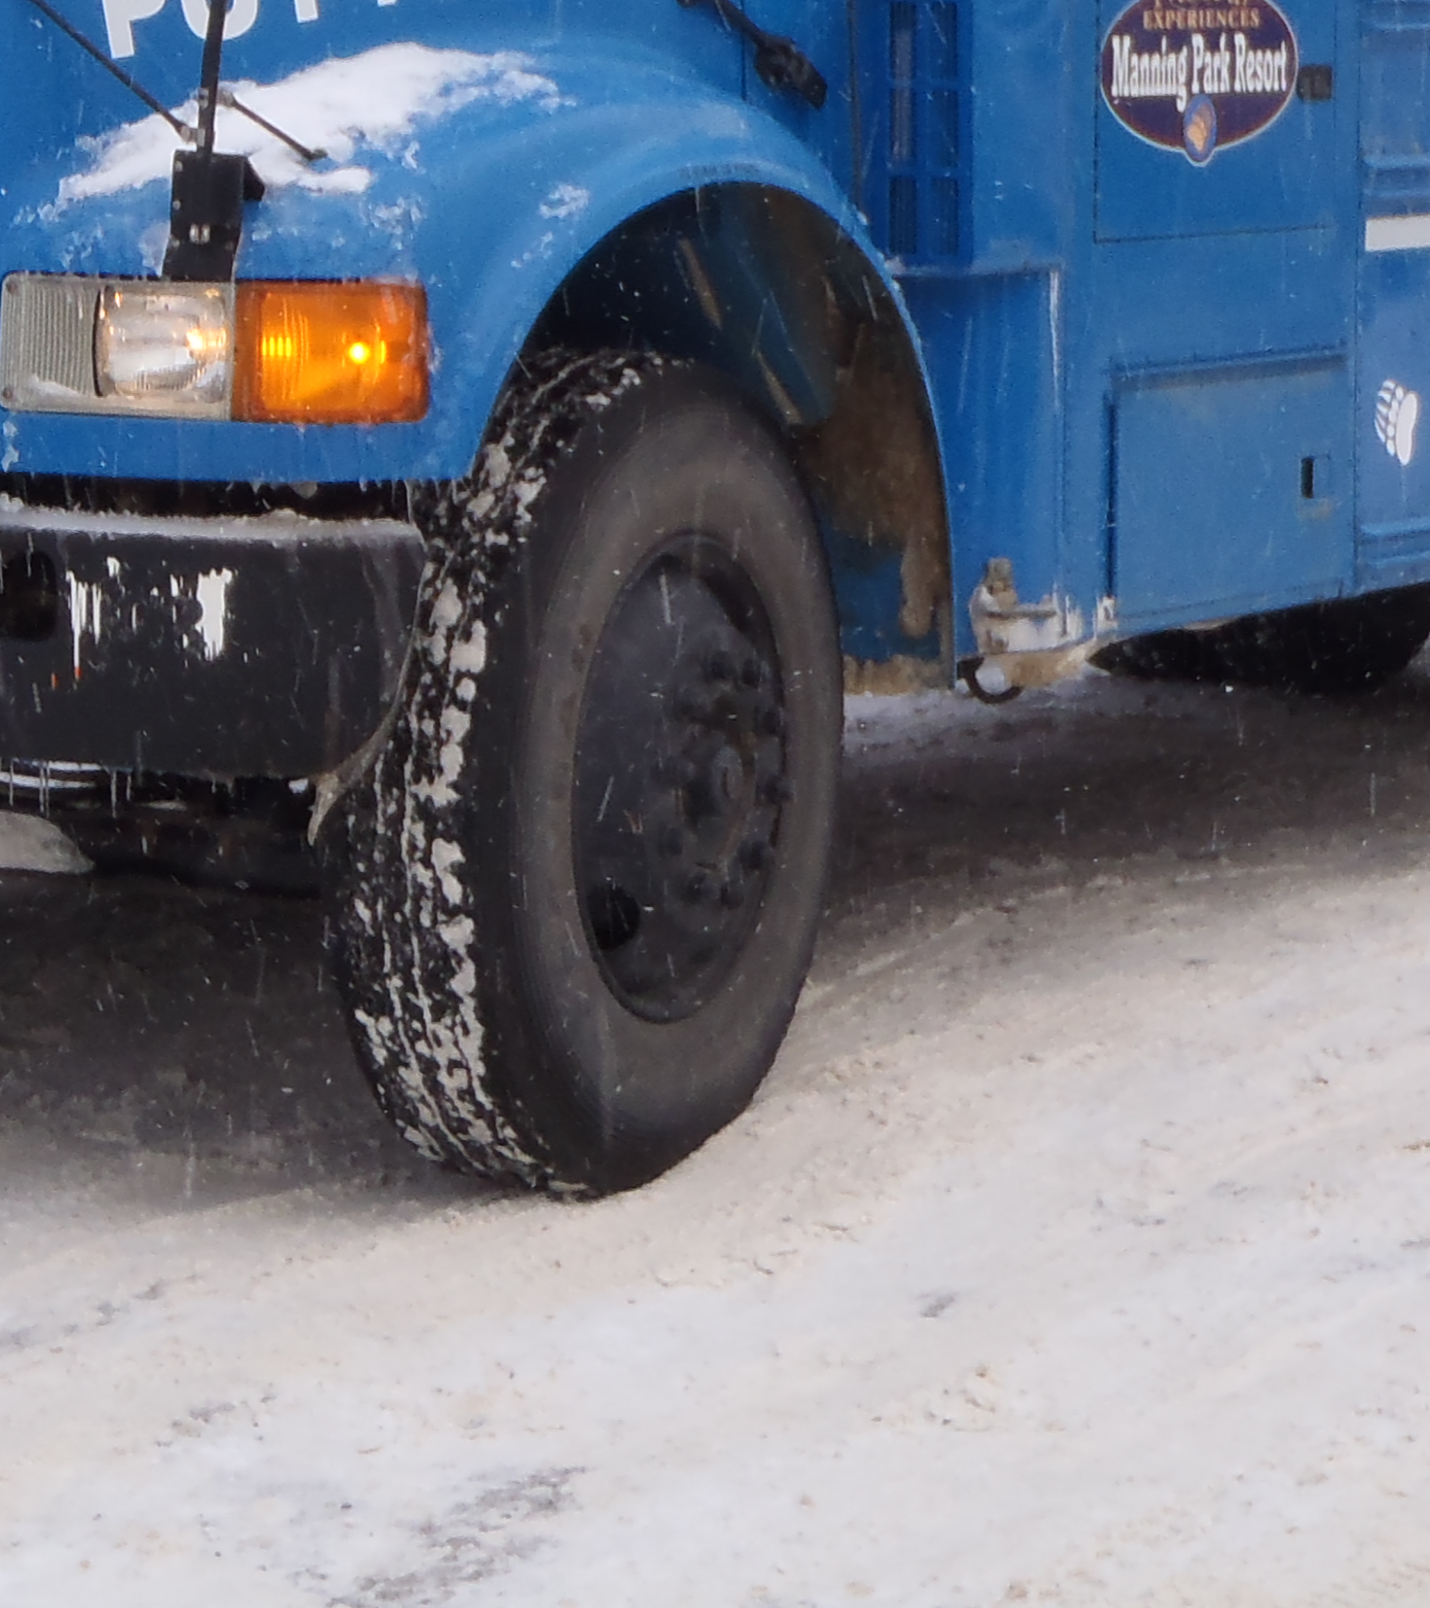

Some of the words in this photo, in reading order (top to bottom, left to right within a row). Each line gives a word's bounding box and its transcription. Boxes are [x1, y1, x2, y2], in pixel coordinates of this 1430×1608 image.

[1143, 7, 1260, 30] EXPERIENCES
[1111, 34, 1188, 113] Manning
[1190, 32, 1231, 94] Park
[1233, 31, 1287, 93] Resort
